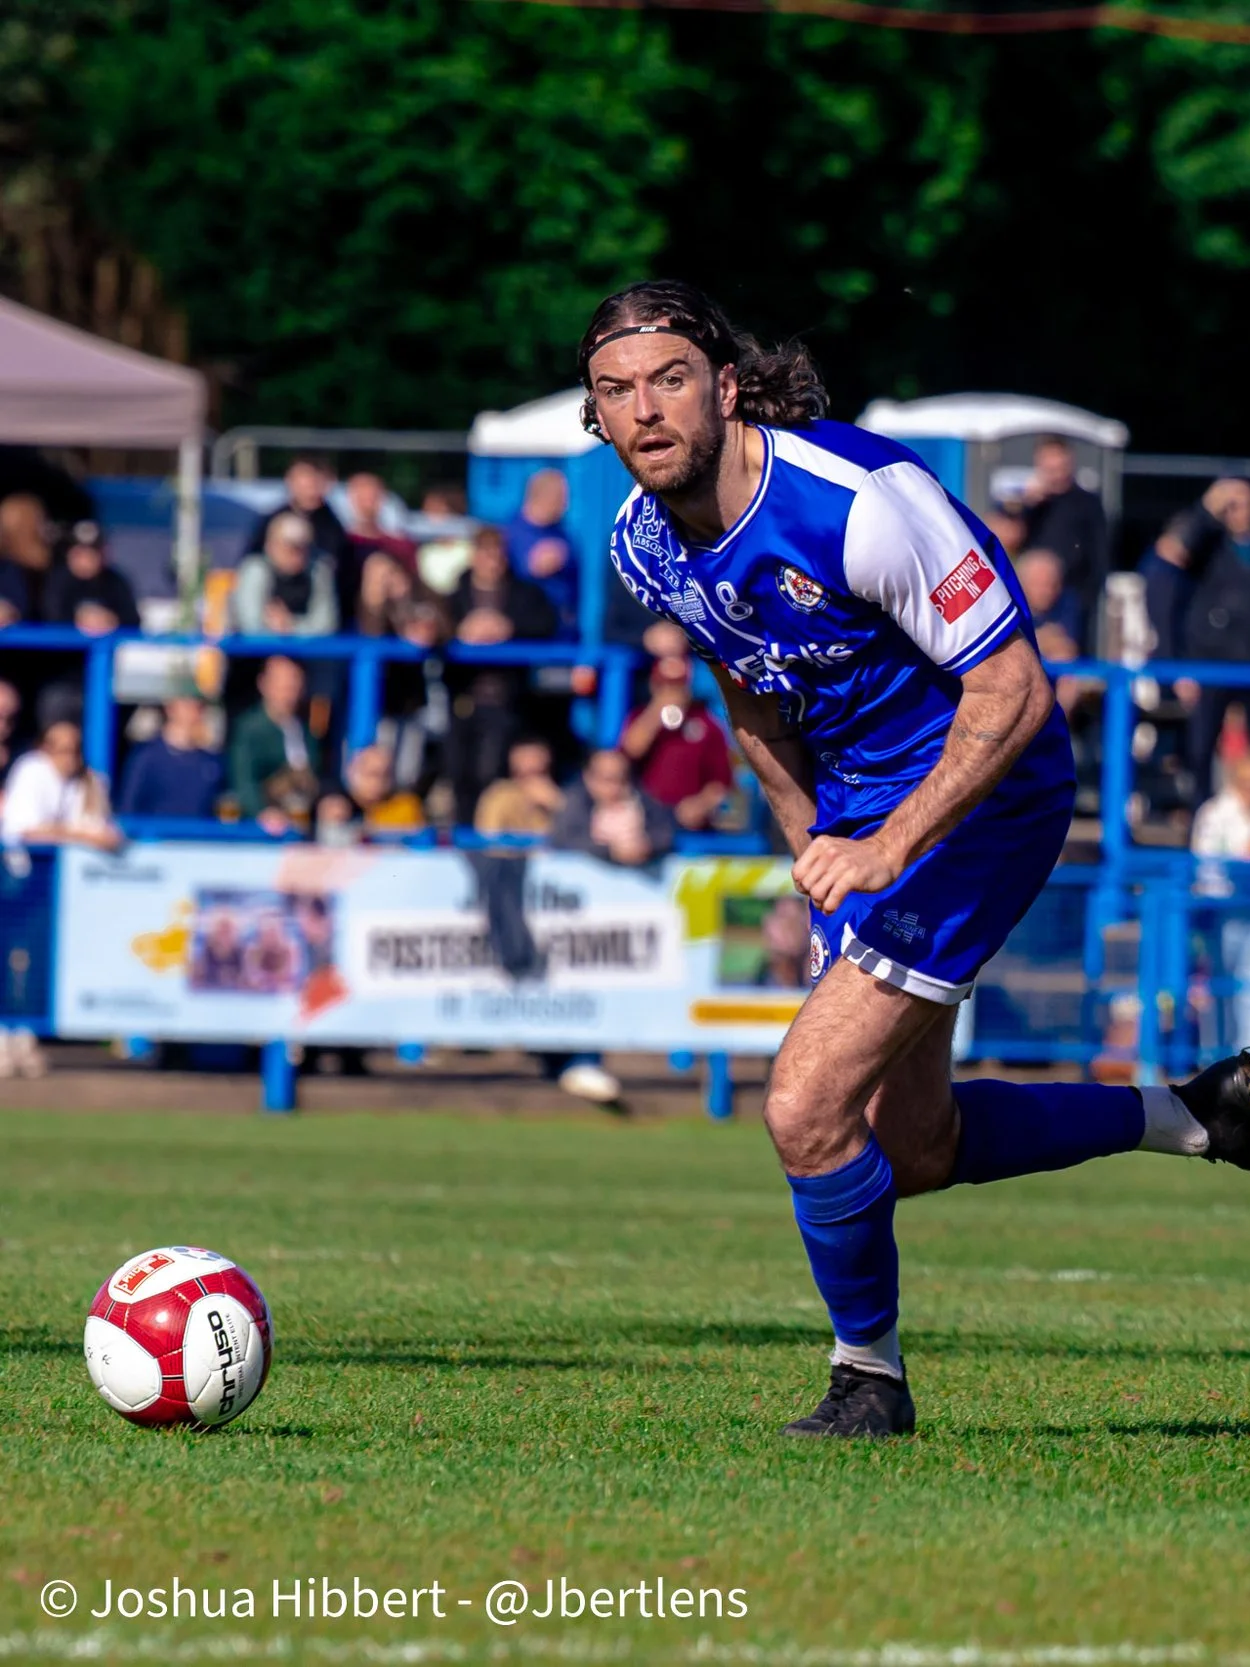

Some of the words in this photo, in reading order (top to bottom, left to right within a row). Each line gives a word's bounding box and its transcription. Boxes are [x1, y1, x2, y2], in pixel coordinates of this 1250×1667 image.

[715, 580, 754, 622] 8
[935, 556, 980, 605] PITCHING
[967, 579, 982, 599] IN
